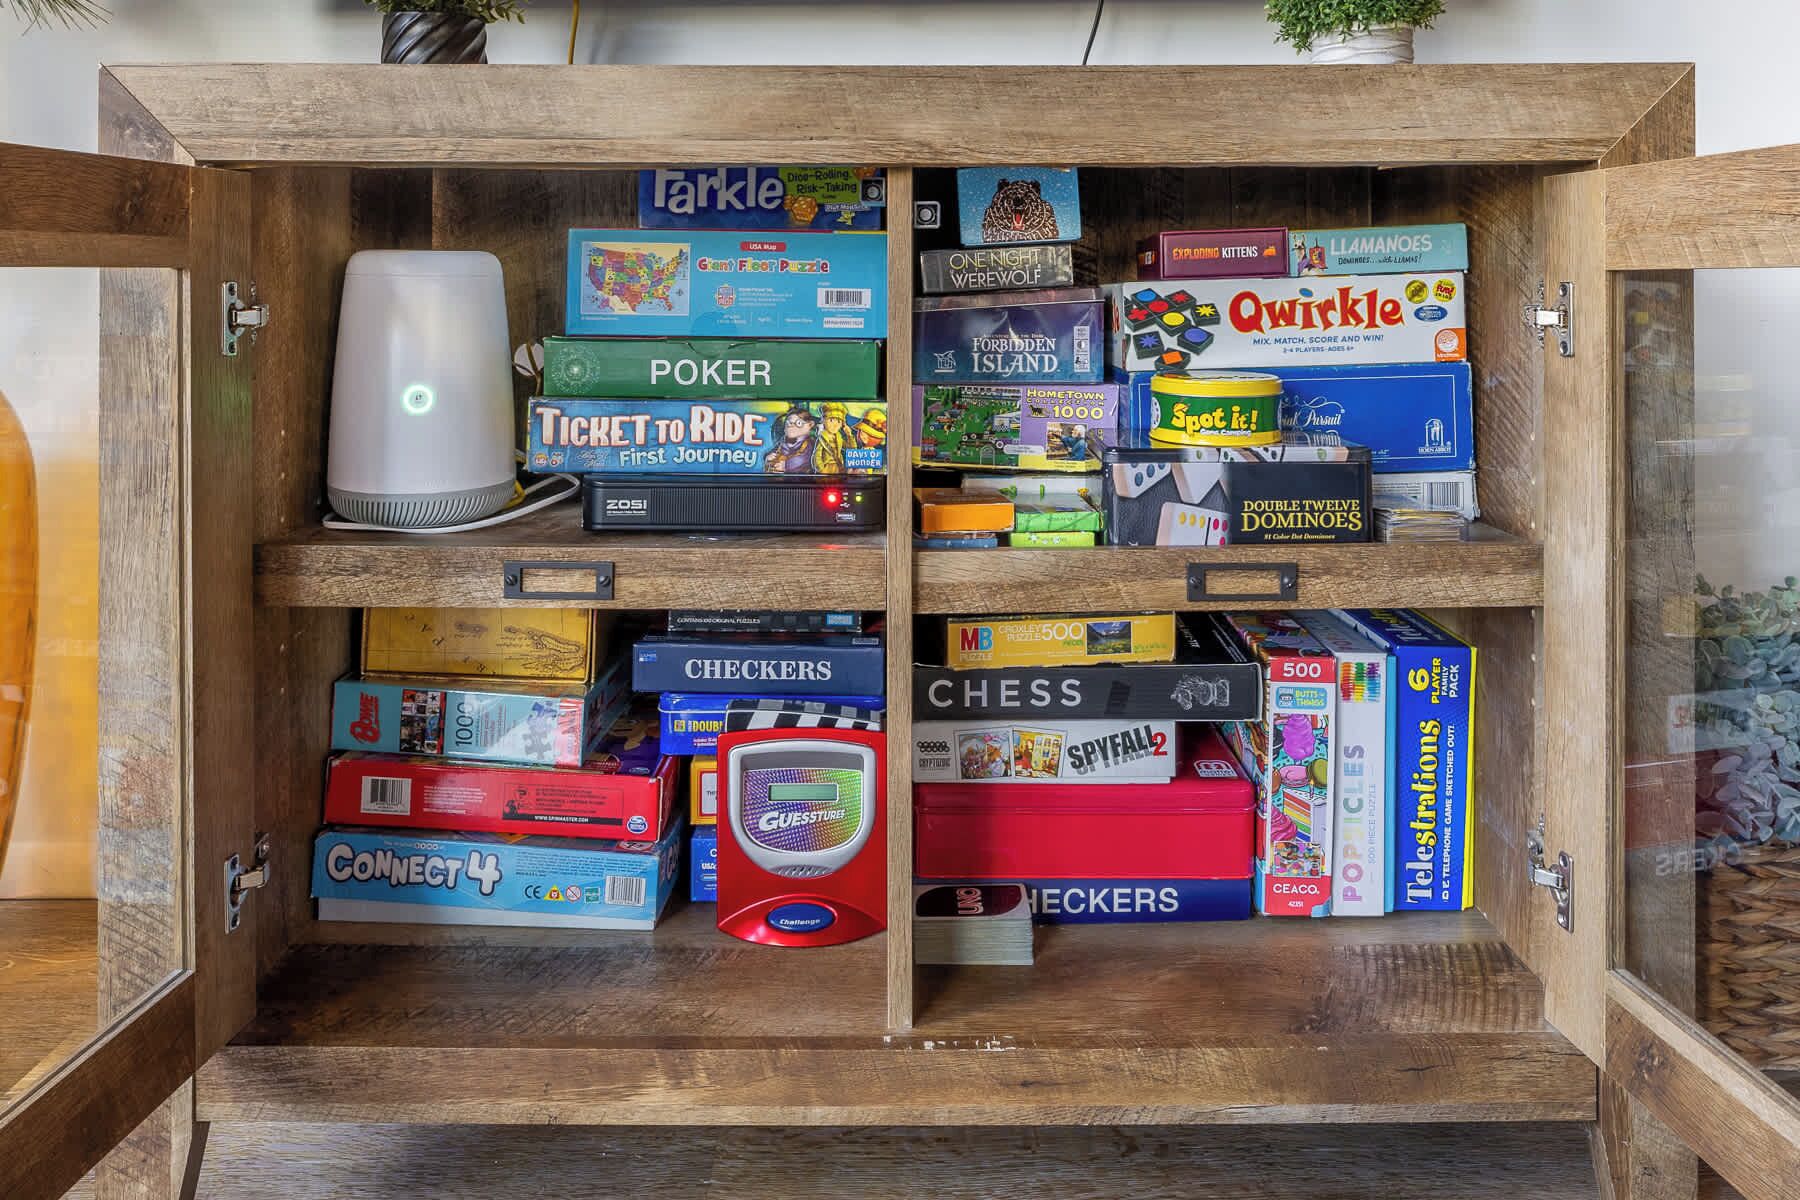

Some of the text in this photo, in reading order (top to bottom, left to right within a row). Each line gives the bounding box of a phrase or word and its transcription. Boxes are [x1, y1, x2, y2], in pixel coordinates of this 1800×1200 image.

[654, 167, 784, 214] Farkle
[949, 249, 1040, 269] ONE NIGHT
[1222, 246, 1258, 258] KITTENS
[697, 257, 829, 273] Giant Floor Puzzle
[950, 269, 1041, 288] WEREWOLF
[1229, 286, 1404, 334] Qwirkle
[971, 336, 1056, 353] FORBIDDEN
[1309, 335, 1338, 344] SCORE
[650, 359, 772, 386] POKER
[971, 352, 1059, 377] ISLAND
[1053, 405, 1104, 419] 1000
[1171, 402, 1226, 437] Spot
[1231, 405, 1258, 431] it!
[1303, 408, 1342, 428] Pursuit
[535, 404, 767, 447] TICKET TO RIDE
[619, 448, 667, 467] First
[673, 446, 757, 468] Journey
[606, 500, 648, 510] ZOSI
[1243, 499, 1360, 511] DOUBLE TWELVE
[1240, 511, 1362, 531] DOMINOES
[960, 626, 993, 651] MB
[1041, 622, 1084, 641] 500
[684, 659, 832, 681] CHECKERS
[1283, 662, 1322, 678] 500
[1408, 668, 1430, 691] 6
[1431, 657, 1441, 704] PLAYER
[1441, 666, 1449, 695] FAMILY
[1449, 664, 1460, 698] PACK
[927, 679, 1082, 708] CHESS
[1067, 725, 1168, 770] SPYFALL 2
[1445, 750, 1454, 796] SKETCHED
[759, 809, 845, 832] GUESSTURES
[1342, 744, 1365, 902] POPSICLES
[1406, 719, 1441, 904] Telestrations
[1444, 798, 1453, 825] GAME
[1443, 827, 1451, 878] TELEPHONE
[327, 844, 464, 888] CONNECT
[466, 850, 501, 896] 4
[956, 888, 985, 915] UNO
[1027, 887, 1180, 914] HECKERS
[779, 917, 821, 926] Challenge
